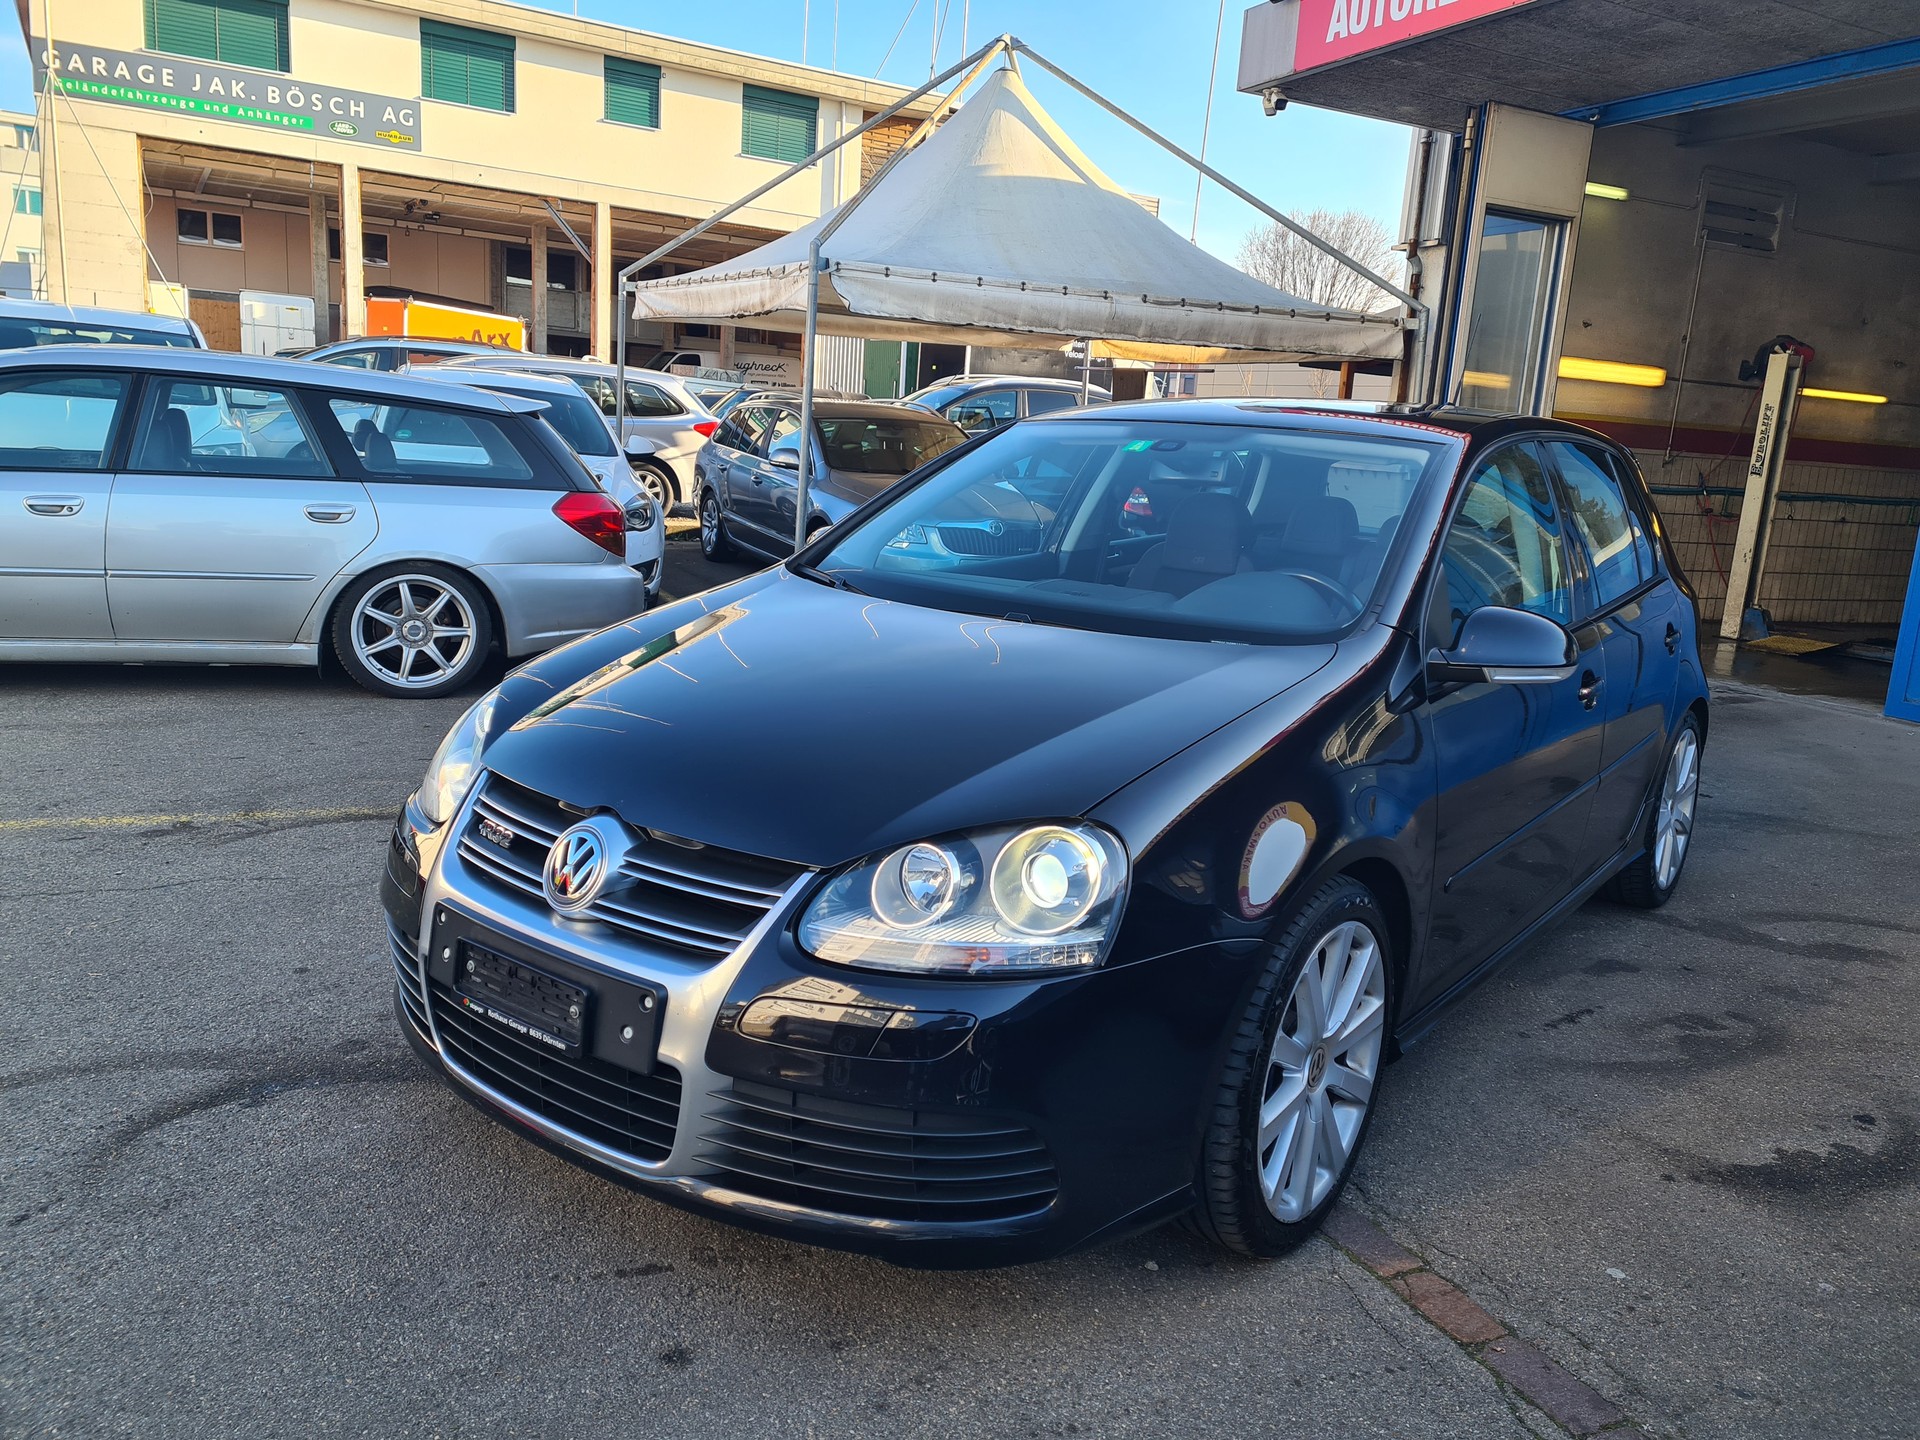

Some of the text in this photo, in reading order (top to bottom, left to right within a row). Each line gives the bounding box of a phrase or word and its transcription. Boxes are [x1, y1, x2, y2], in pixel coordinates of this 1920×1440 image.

[41, 49, 415, 127] GARAGE JAK. BÖSCH AG
[53, 78, 305, 126] Geländefahrzeuge und Anhänger
[487, 1008, 508, 1025] Rothaus
[508, 1019, 528, 1034] Garage
[529, 1028, 543, 1040] 8635
[543, 1033, 566, 1051] Dürnten
